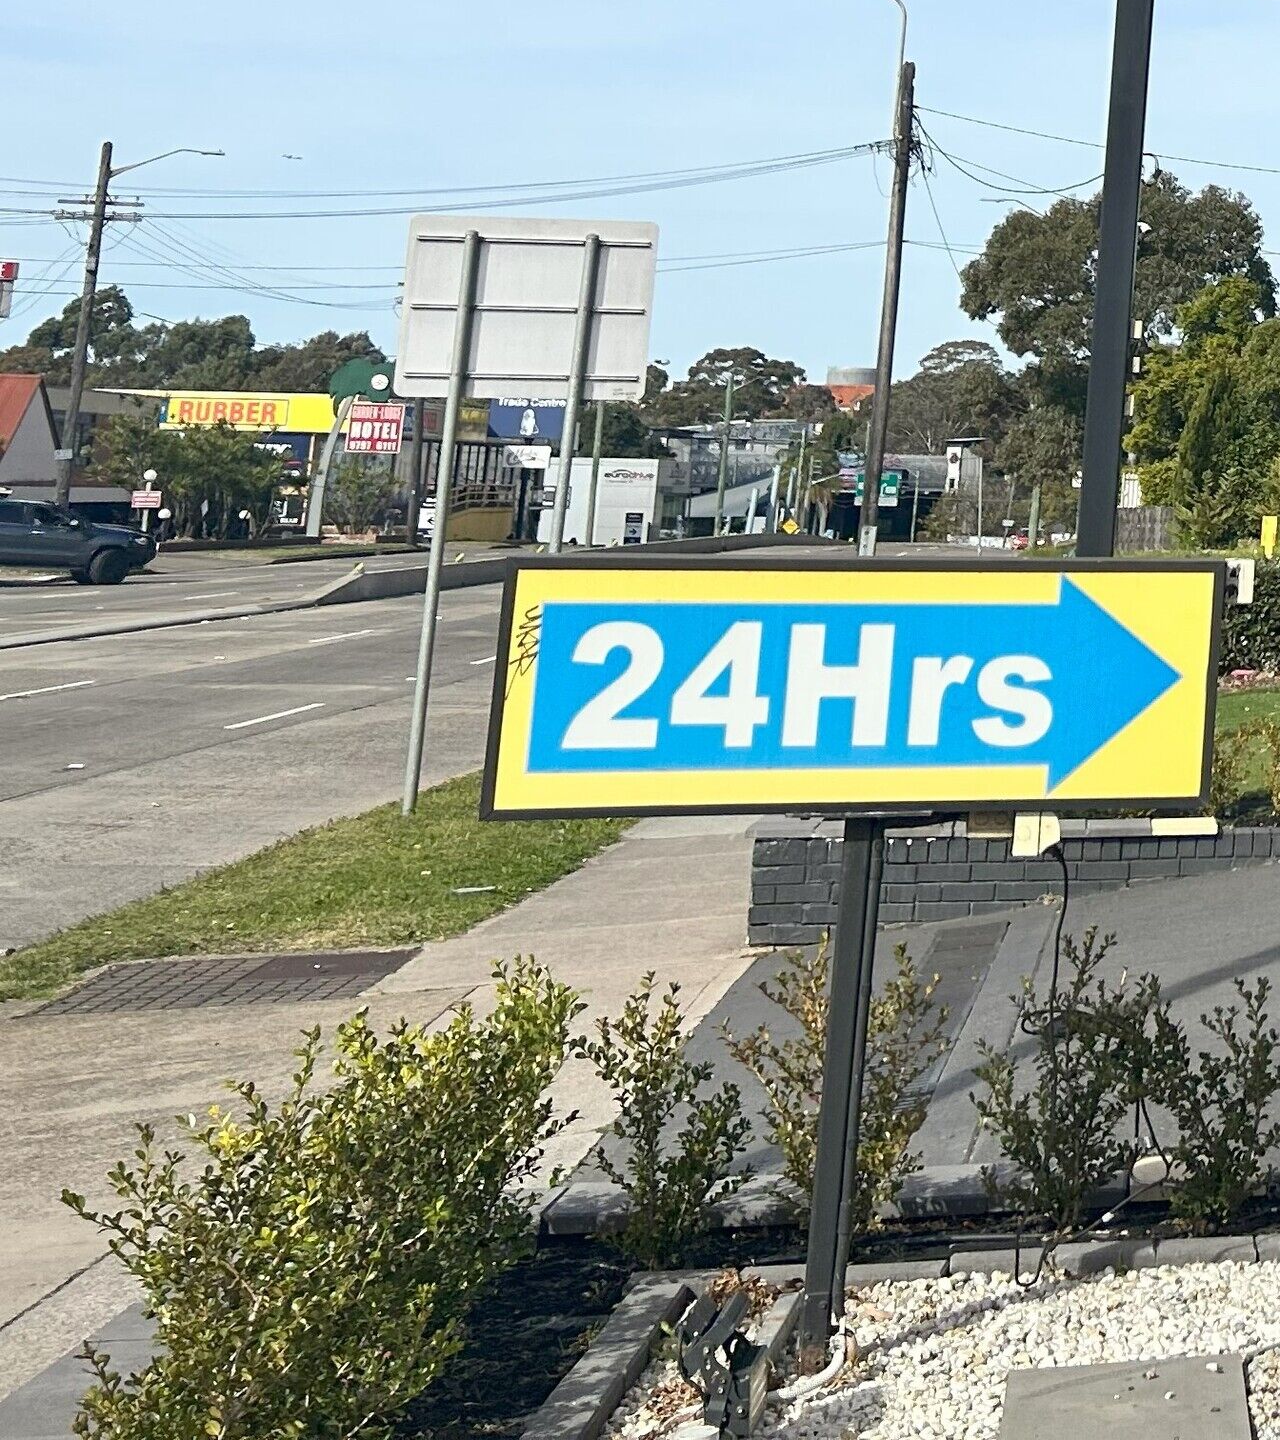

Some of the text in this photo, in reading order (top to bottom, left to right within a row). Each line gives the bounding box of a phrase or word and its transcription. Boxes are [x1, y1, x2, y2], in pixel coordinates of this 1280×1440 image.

[179, 401, 277, 423] RUBBER
[498, 398, 567, 407] Trade Centre
[560, 620, 1053, 749] 24Hrs
